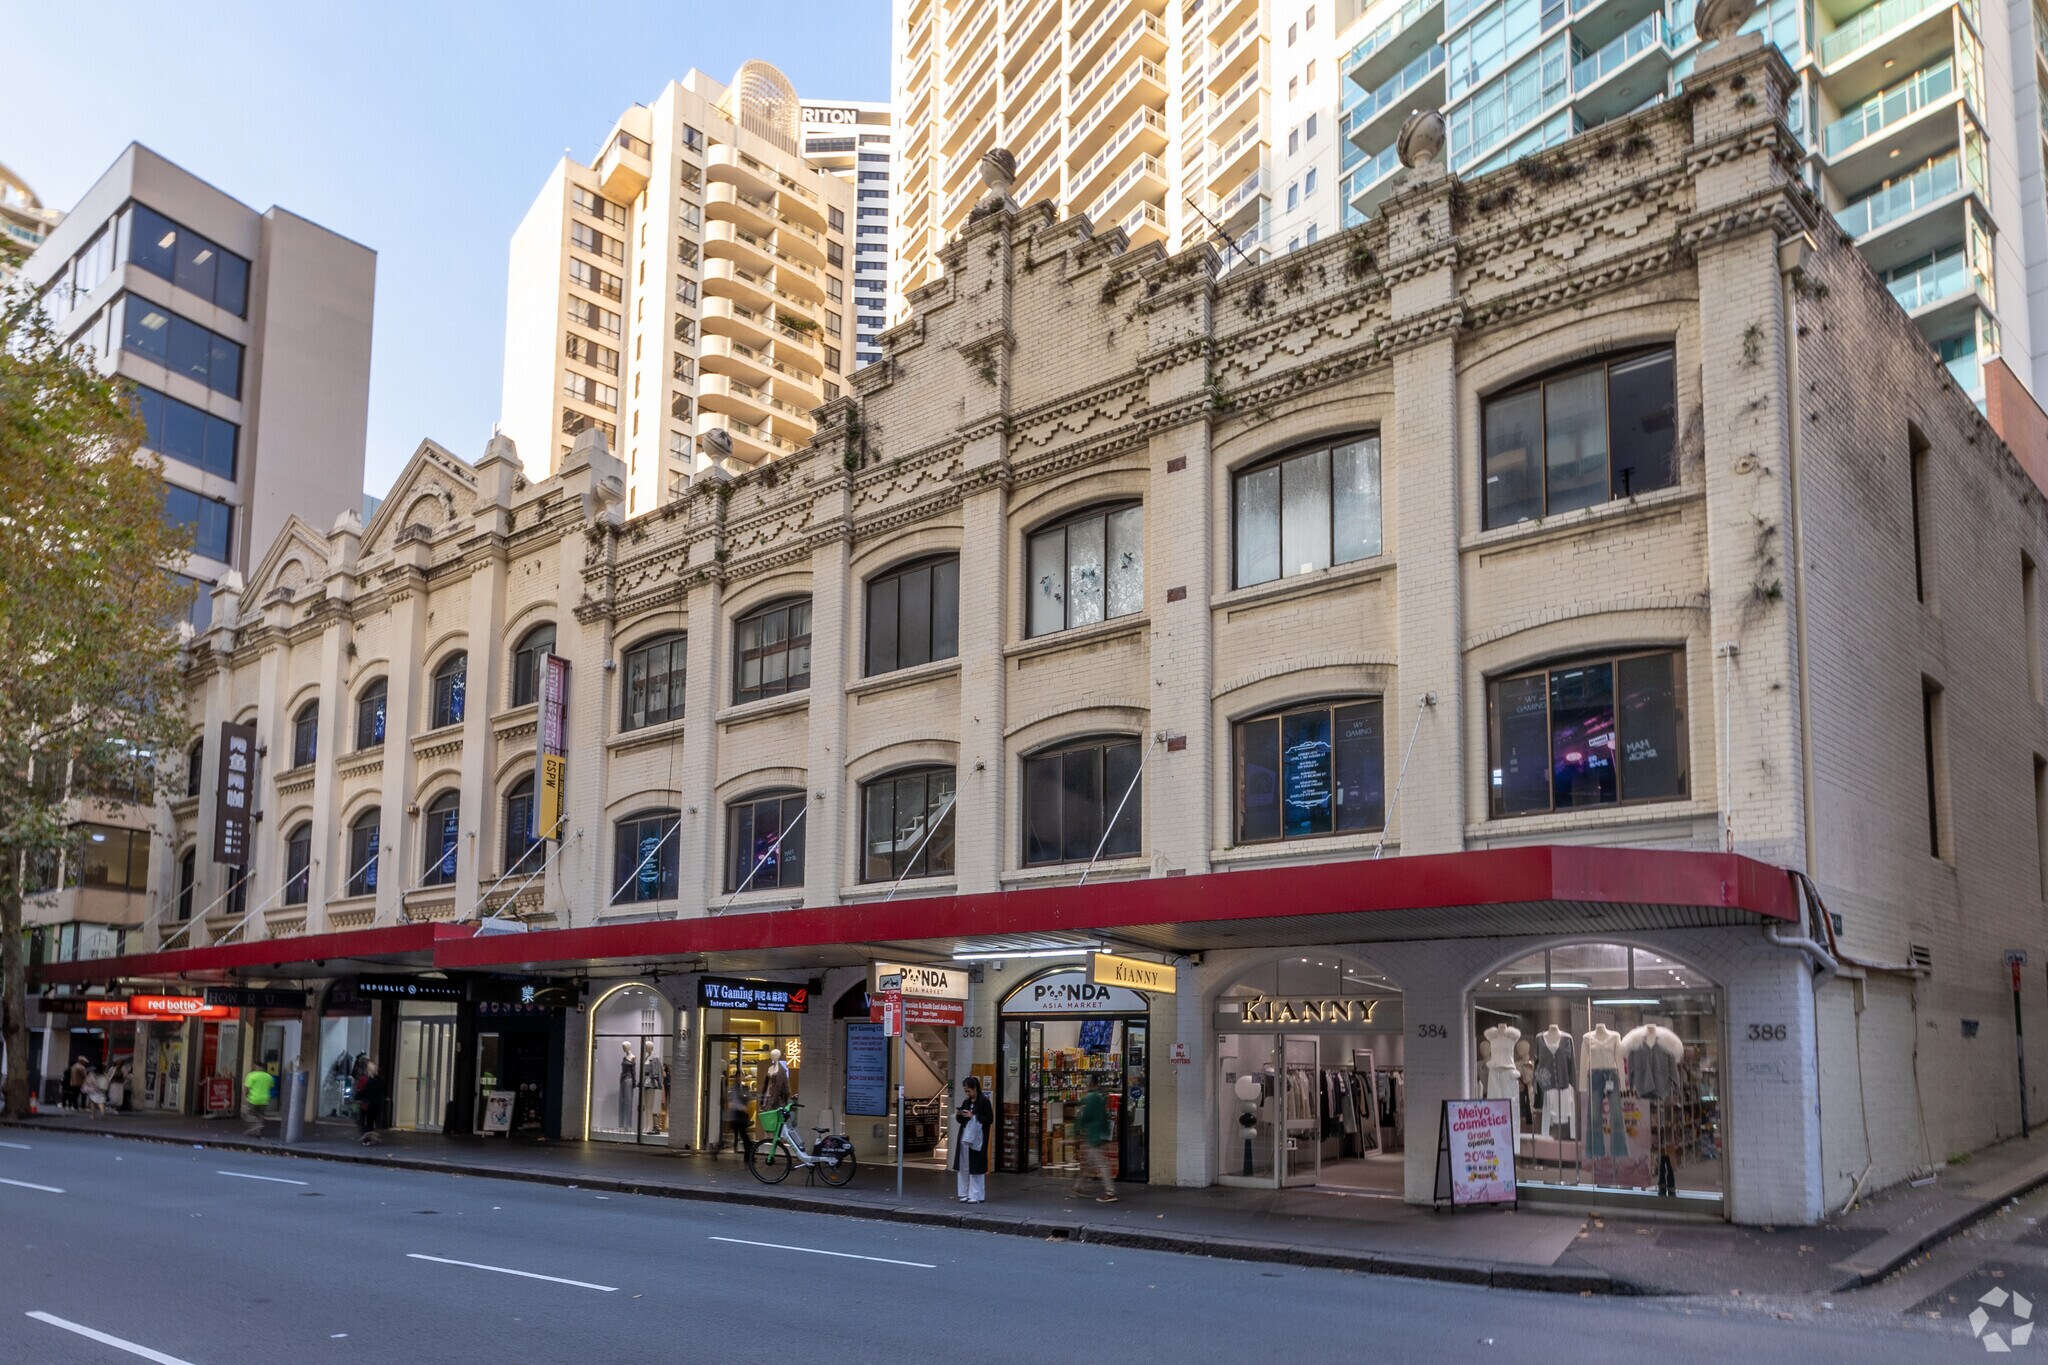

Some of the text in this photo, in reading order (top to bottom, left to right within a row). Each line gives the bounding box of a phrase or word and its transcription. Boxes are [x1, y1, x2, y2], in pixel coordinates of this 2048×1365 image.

[1345, 728, 1372, 737] GAMING
[360, 983, 405, 992] REPUBLIC
[704, 983, 753, 1002] WY Gaming
[100, 1005, 119, 1016] red
[148, 1000, 196, 1011] red bottle
[962, 1026, 983, 1038] 382
[1418, 1024, 1448, 1038] 384
[1748, 1023, 1787, 1041] 386
[1458, 1105, 1490, 1120] Meiyo
[1453, 1113, 1508, 1132] cosmetics
[1467, 1130, 1491, 1140] Grand
[1468, 1138, 1495, 1149] opening
